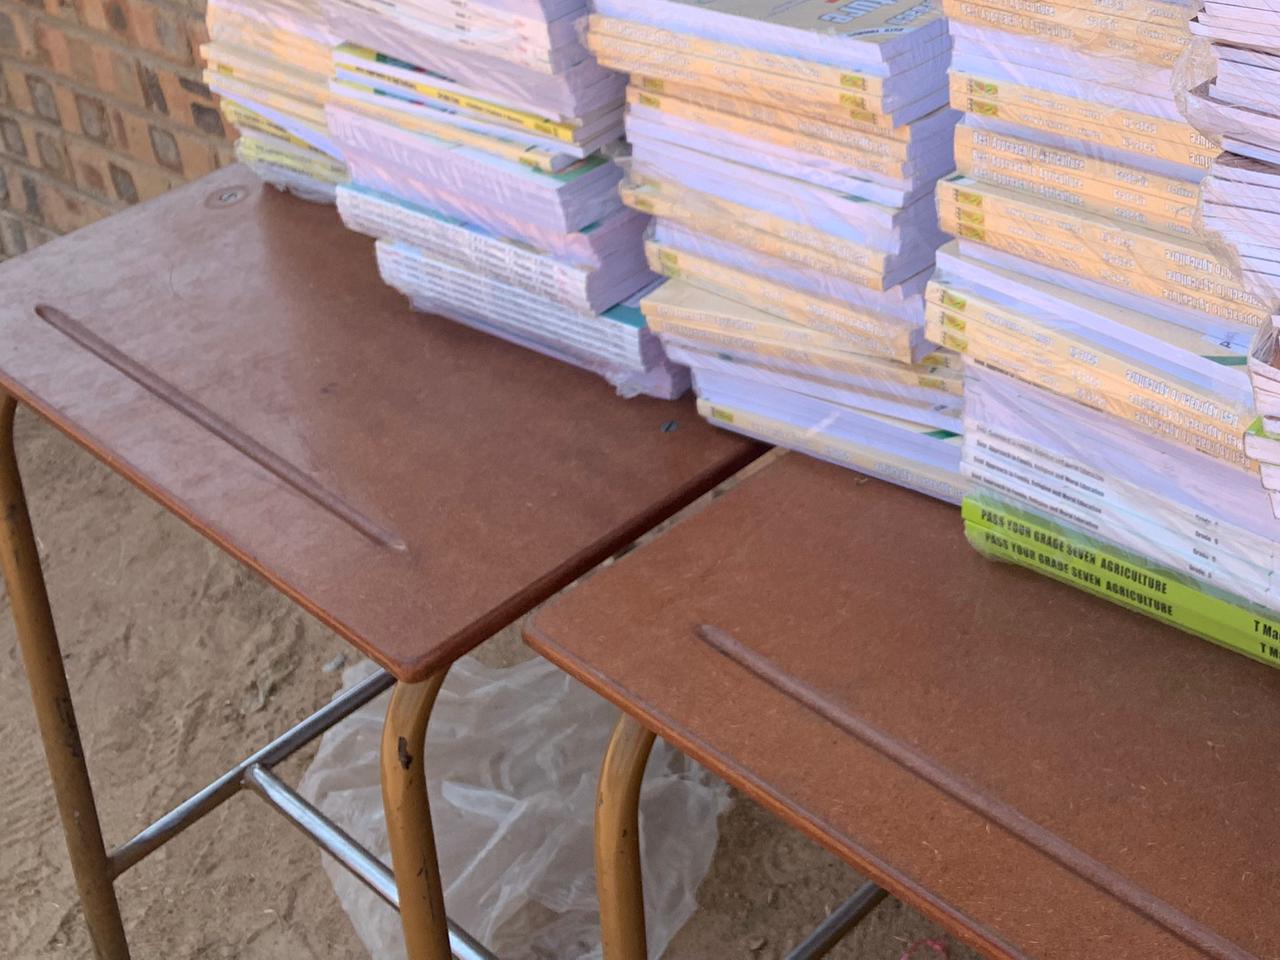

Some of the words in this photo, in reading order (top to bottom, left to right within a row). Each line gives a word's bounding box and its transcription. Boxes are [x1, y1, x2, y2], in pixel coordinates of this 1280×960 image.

[981, 509, 1004, 528] PASS
[1008, 519, 1032, 538] YOUR
[1034, 526, 1064, 550] GRADE
[1066, 541, 1096, 566] SEVEN
[1100, 558, 1168, 595] AGRICULTURE
[985, 532, 1008, 551] PASS
[1012, 542, 1036, 562] YOUR
[1038, 550, 1069, 574] GRADE
[1072, 562, 1101, 586] SEVEN
[1105, 579, 1174, 618] AGRICULTURE
[1254, 620, 1260, 632] T
[1260, 642, 1266, 654] T
